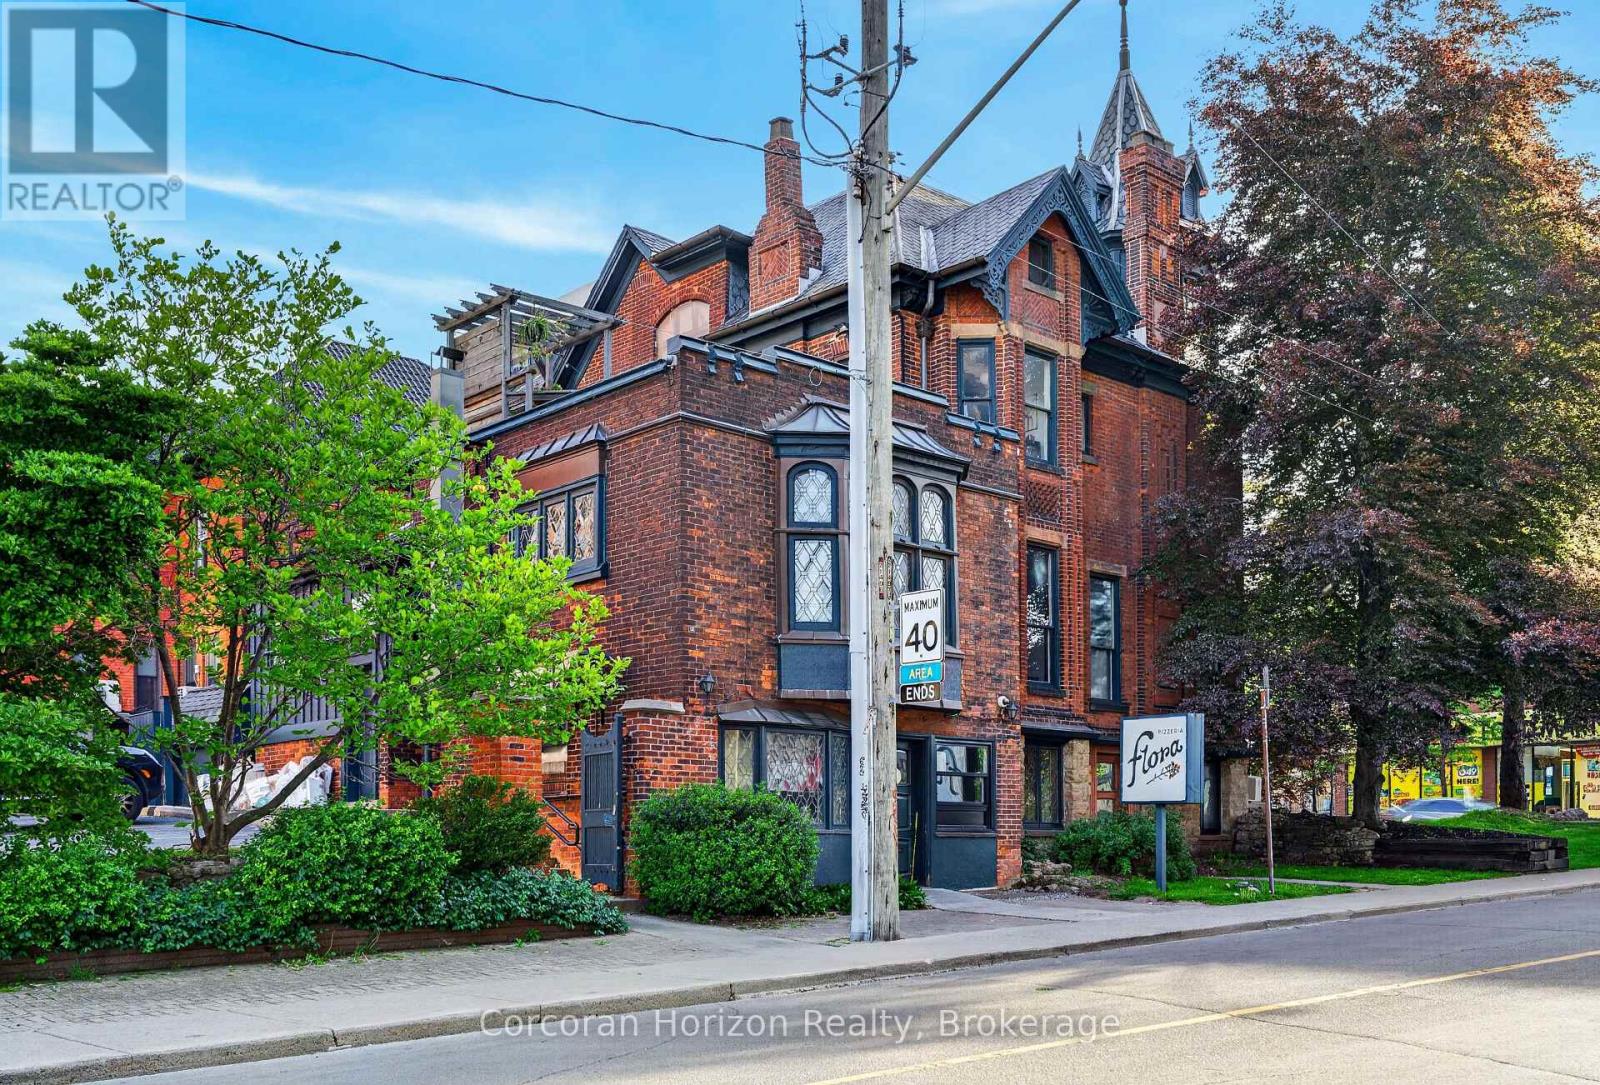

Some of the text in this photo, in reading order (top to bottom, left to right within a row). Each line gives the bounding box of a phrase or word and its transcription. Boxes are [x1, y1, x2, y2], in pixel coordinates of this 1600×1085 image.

[904, 598, 938, 612] MAXIMUM
[905, 620, 938, 653] 40
[909, 666, 933, 680] AREA
[906, 684, 935, 701] ENDS
